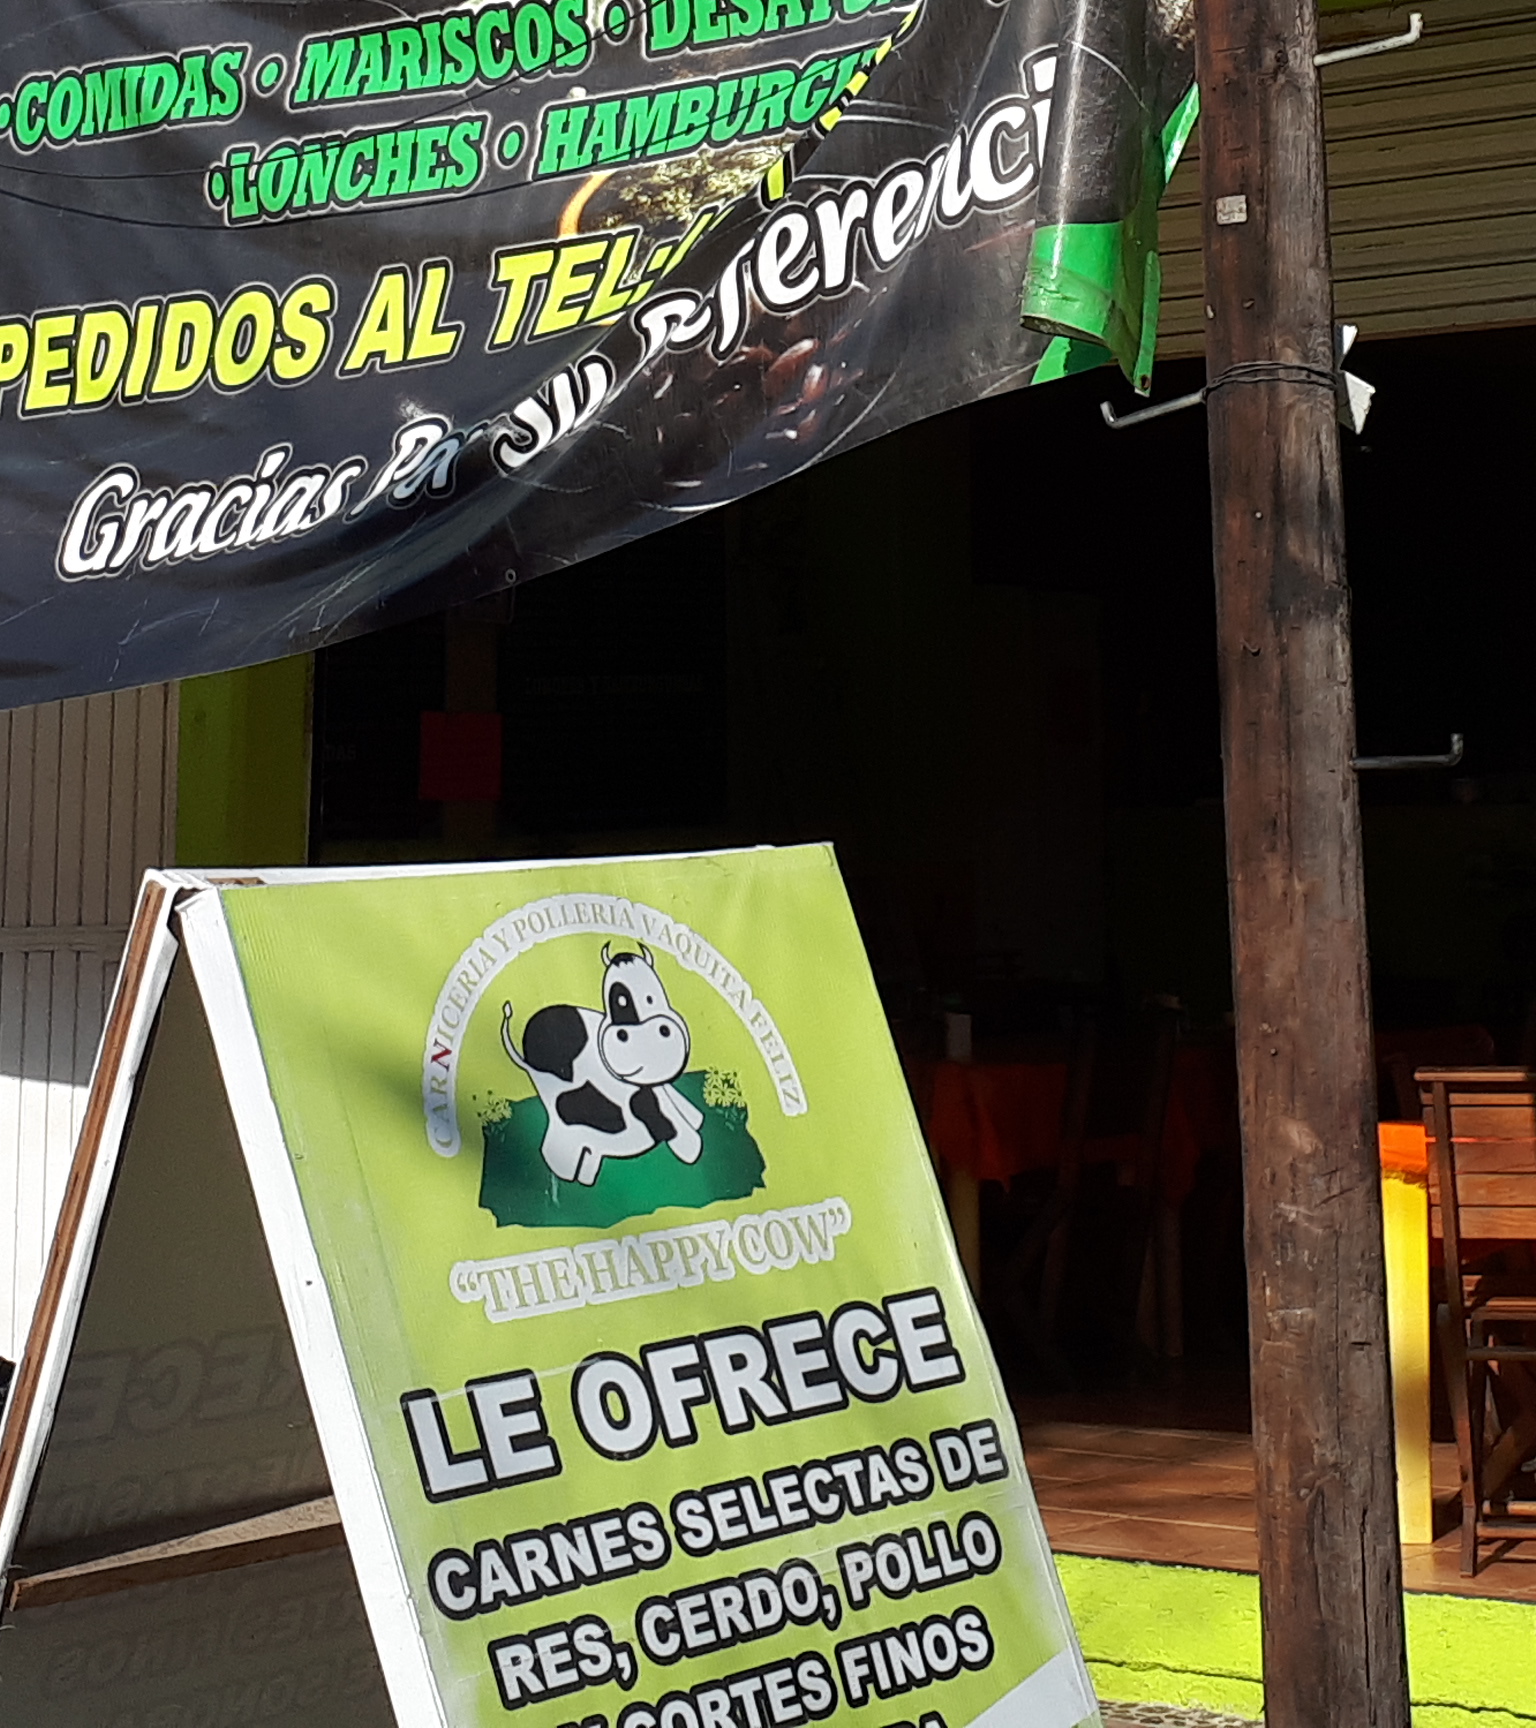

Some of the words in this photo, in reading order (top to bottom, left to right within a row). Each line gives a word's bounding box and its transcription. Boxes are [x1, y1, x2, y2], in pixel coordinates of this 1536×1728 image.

[14, 48, 244, 148] COMIDAS
[227, 120, 483, 220] LONCHES
[340, 262, 463, 372] AL
[60, 444, 362, 579] Gracias
[431, 945, 498, 1149] CARNICERIA
[492, 929, 513, 953] Y
[511, 901, 636, 943] POLLERIA
[640, 913, 749, 1011] VAQUITA
[749, 1010, 801, 1110] FELIZ
[580, 1229, 734, 1293] HAPPY
[403, 1371, 558, 1499] LE
[573, 1289, 962, 1459] OFRECE
[429, 1506, 670, 1618] CARNES
[674, 1442, 930, 1556] SELECTAS
[933, 1421, 1006, 1490] DE
[491, 1618, 634, 1703] RES,
[638, 1562, 840, 1659] CERDO,
[839, 1515, 1000, 1606] POLLO
[844, 1612, 992, 1701] FINOS
